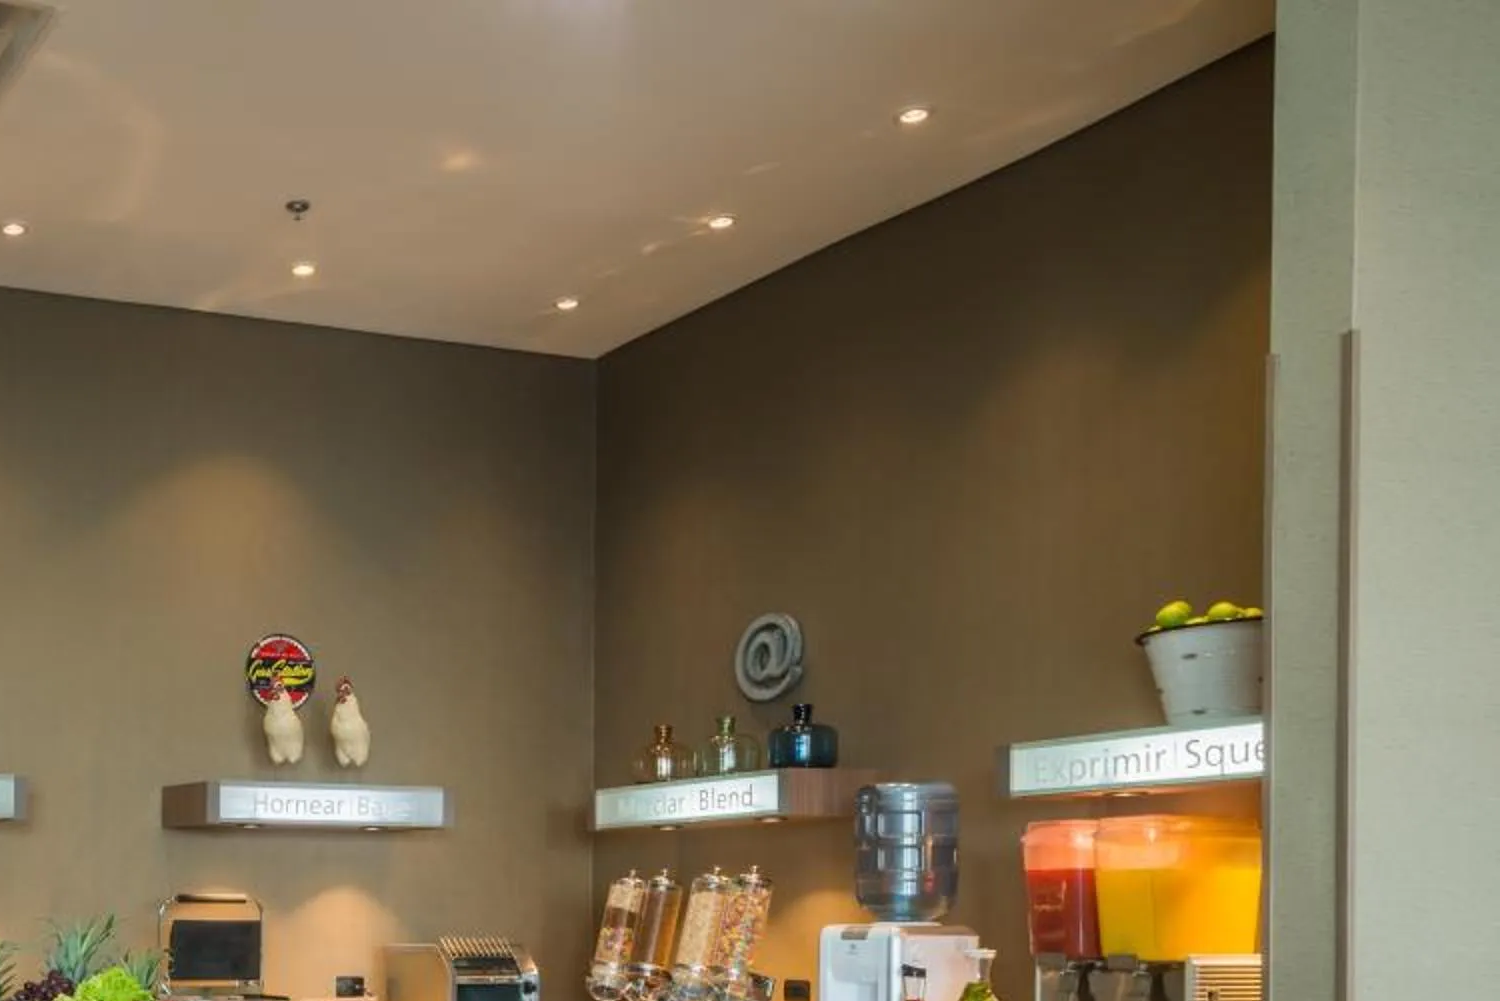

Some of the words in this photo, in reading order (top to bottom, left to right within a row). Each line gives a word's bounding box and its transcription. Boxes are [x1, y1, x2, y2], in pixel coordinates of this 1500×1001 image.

[1032, 743, 1167, 785] Exprimir
[253, 793, 345, 816] Hornear
[699, 784, 754, 811] Blend
